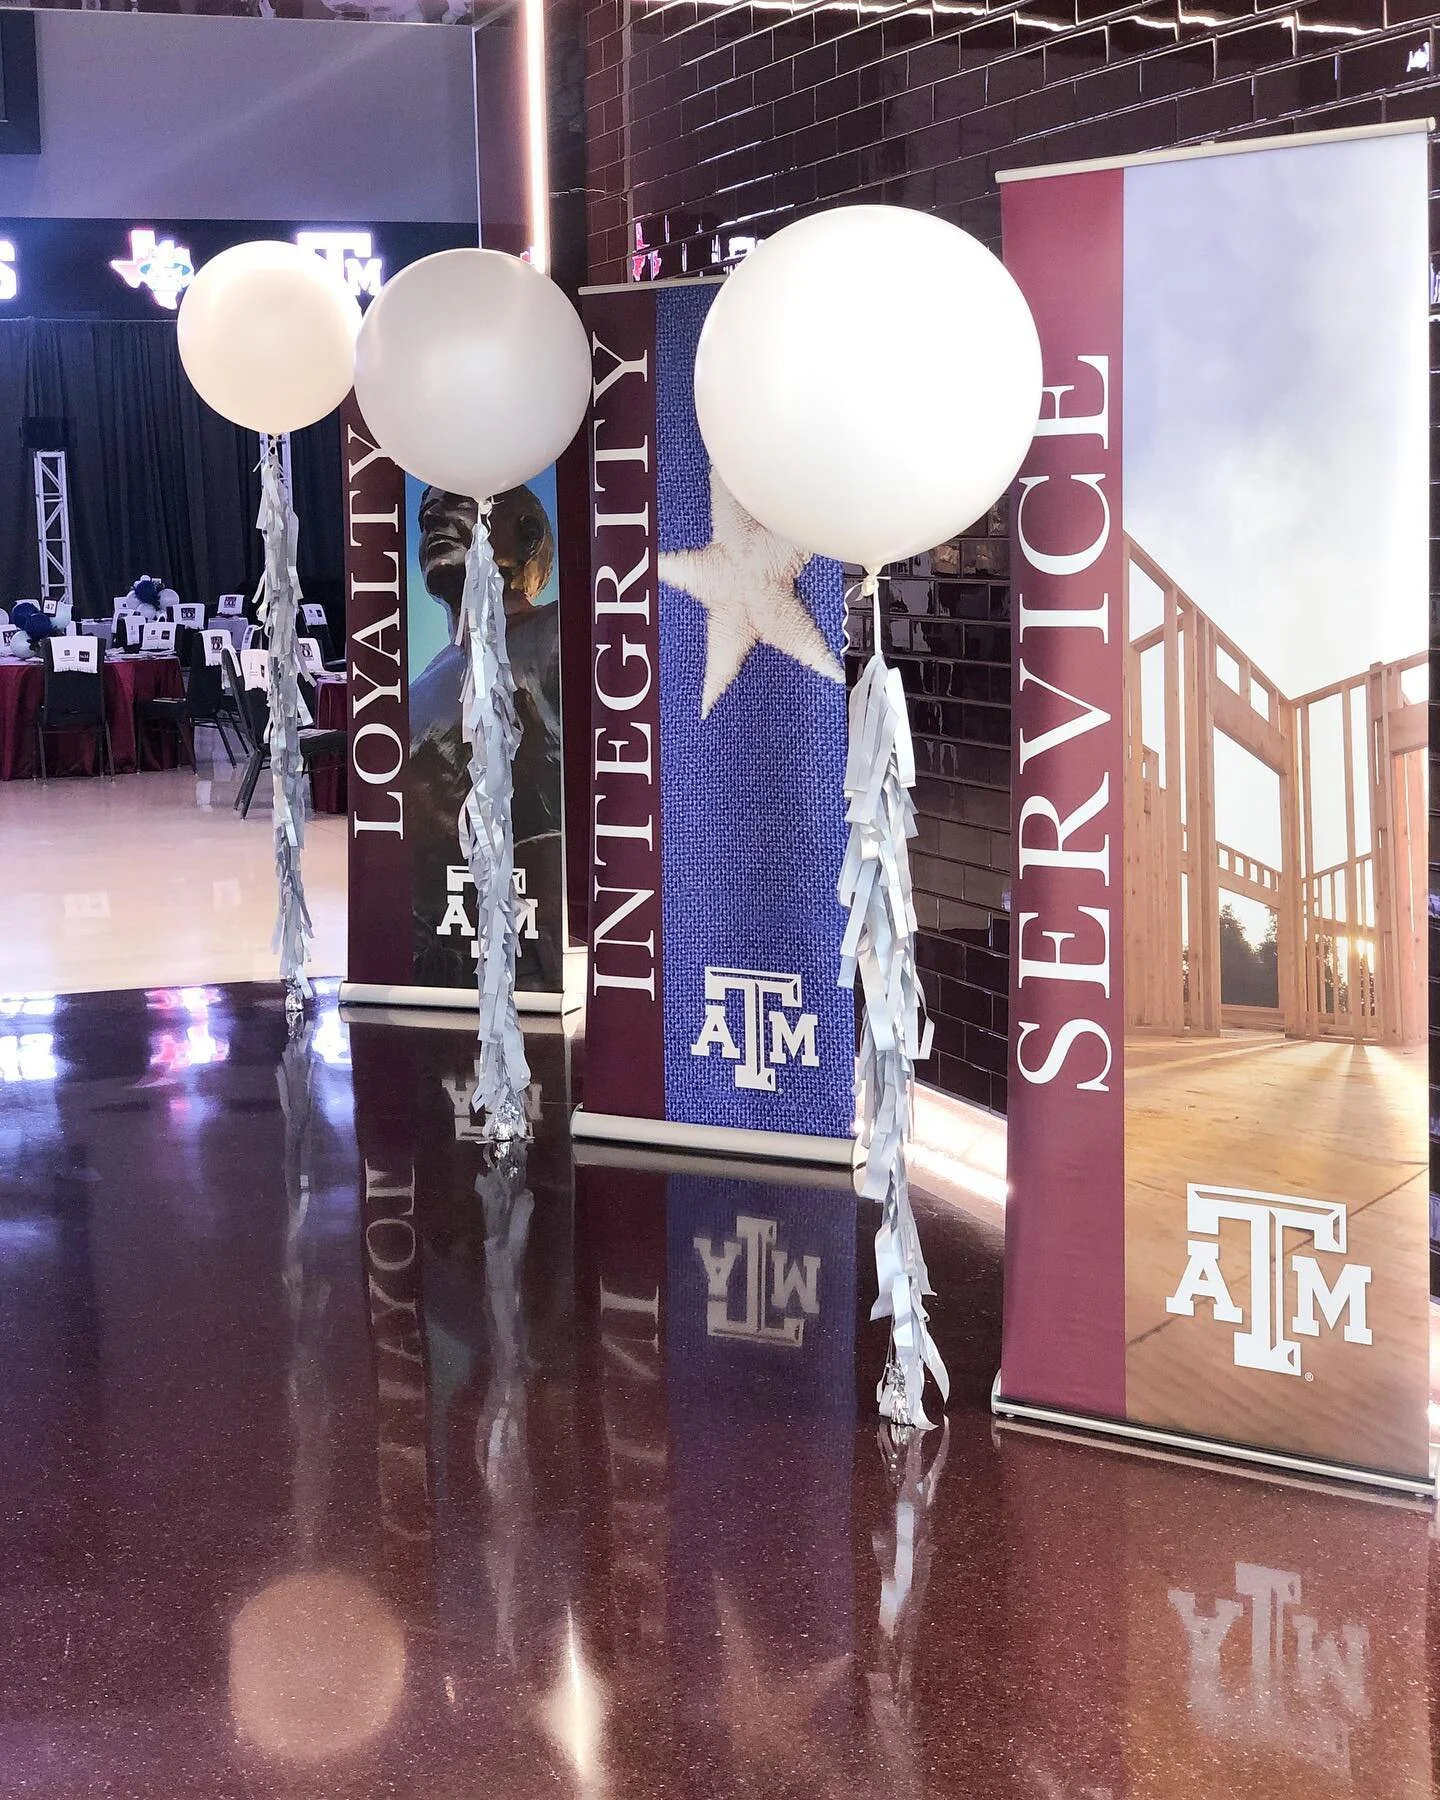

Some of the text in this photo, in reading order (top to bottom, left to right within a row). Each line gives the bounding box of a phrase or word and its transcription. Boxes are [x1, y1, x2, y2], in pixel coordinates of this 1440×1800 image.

[347, 423, 404, 840] LOYALTY
[592, 330, 656, 1002] INTEGRITY
[1016, 354, 1113, 1093] SERVICE
